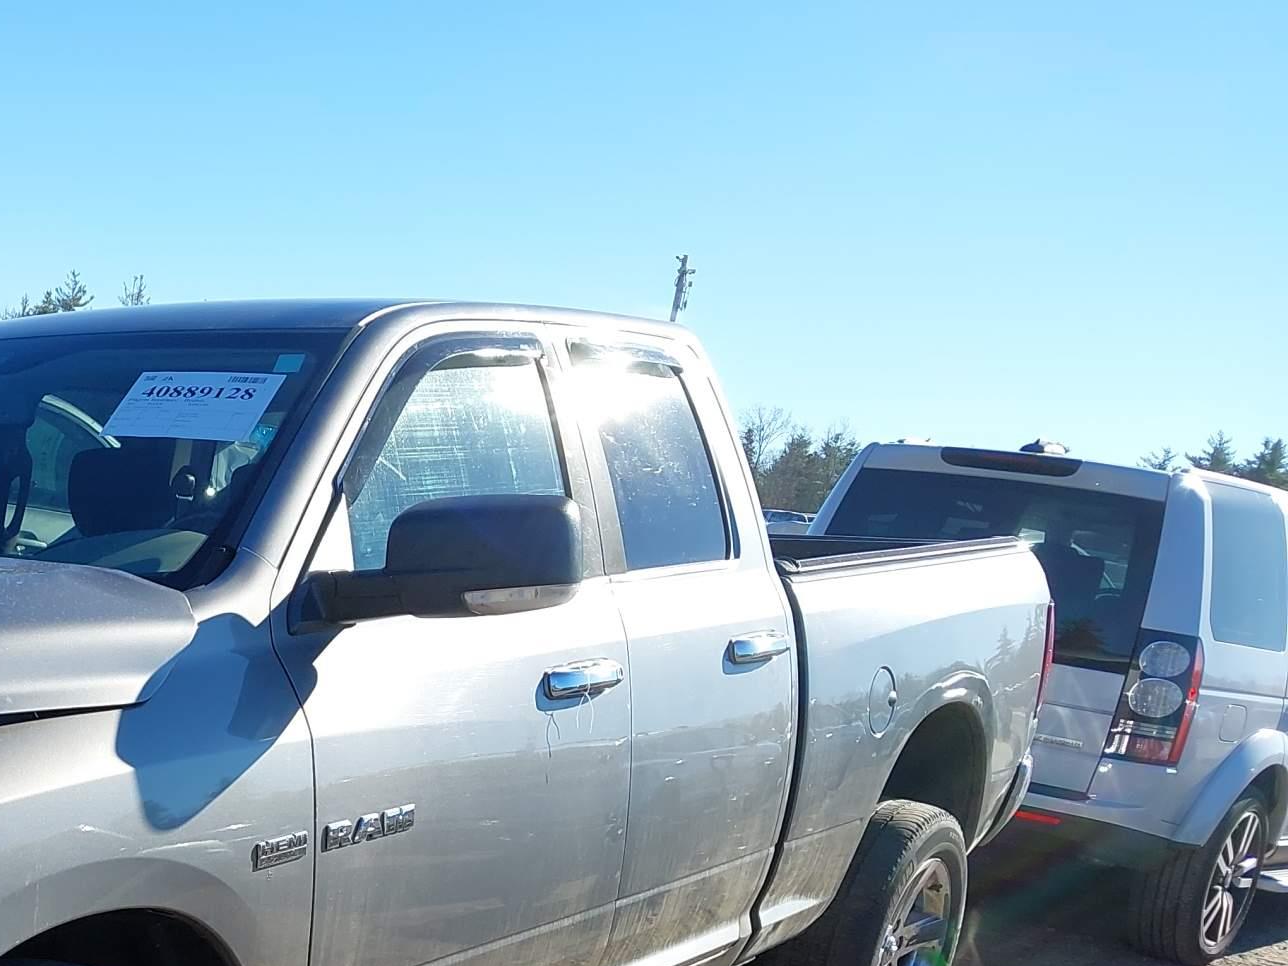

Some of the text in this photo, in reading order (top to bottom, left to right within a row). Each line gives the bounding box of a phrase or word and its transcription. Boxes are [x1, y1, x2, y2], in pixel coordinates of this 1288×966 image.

[141, 384, 257, 401] 40889128
[320, 803, 416, 853] RAM
[257, 830, 308, 858] HEMI
